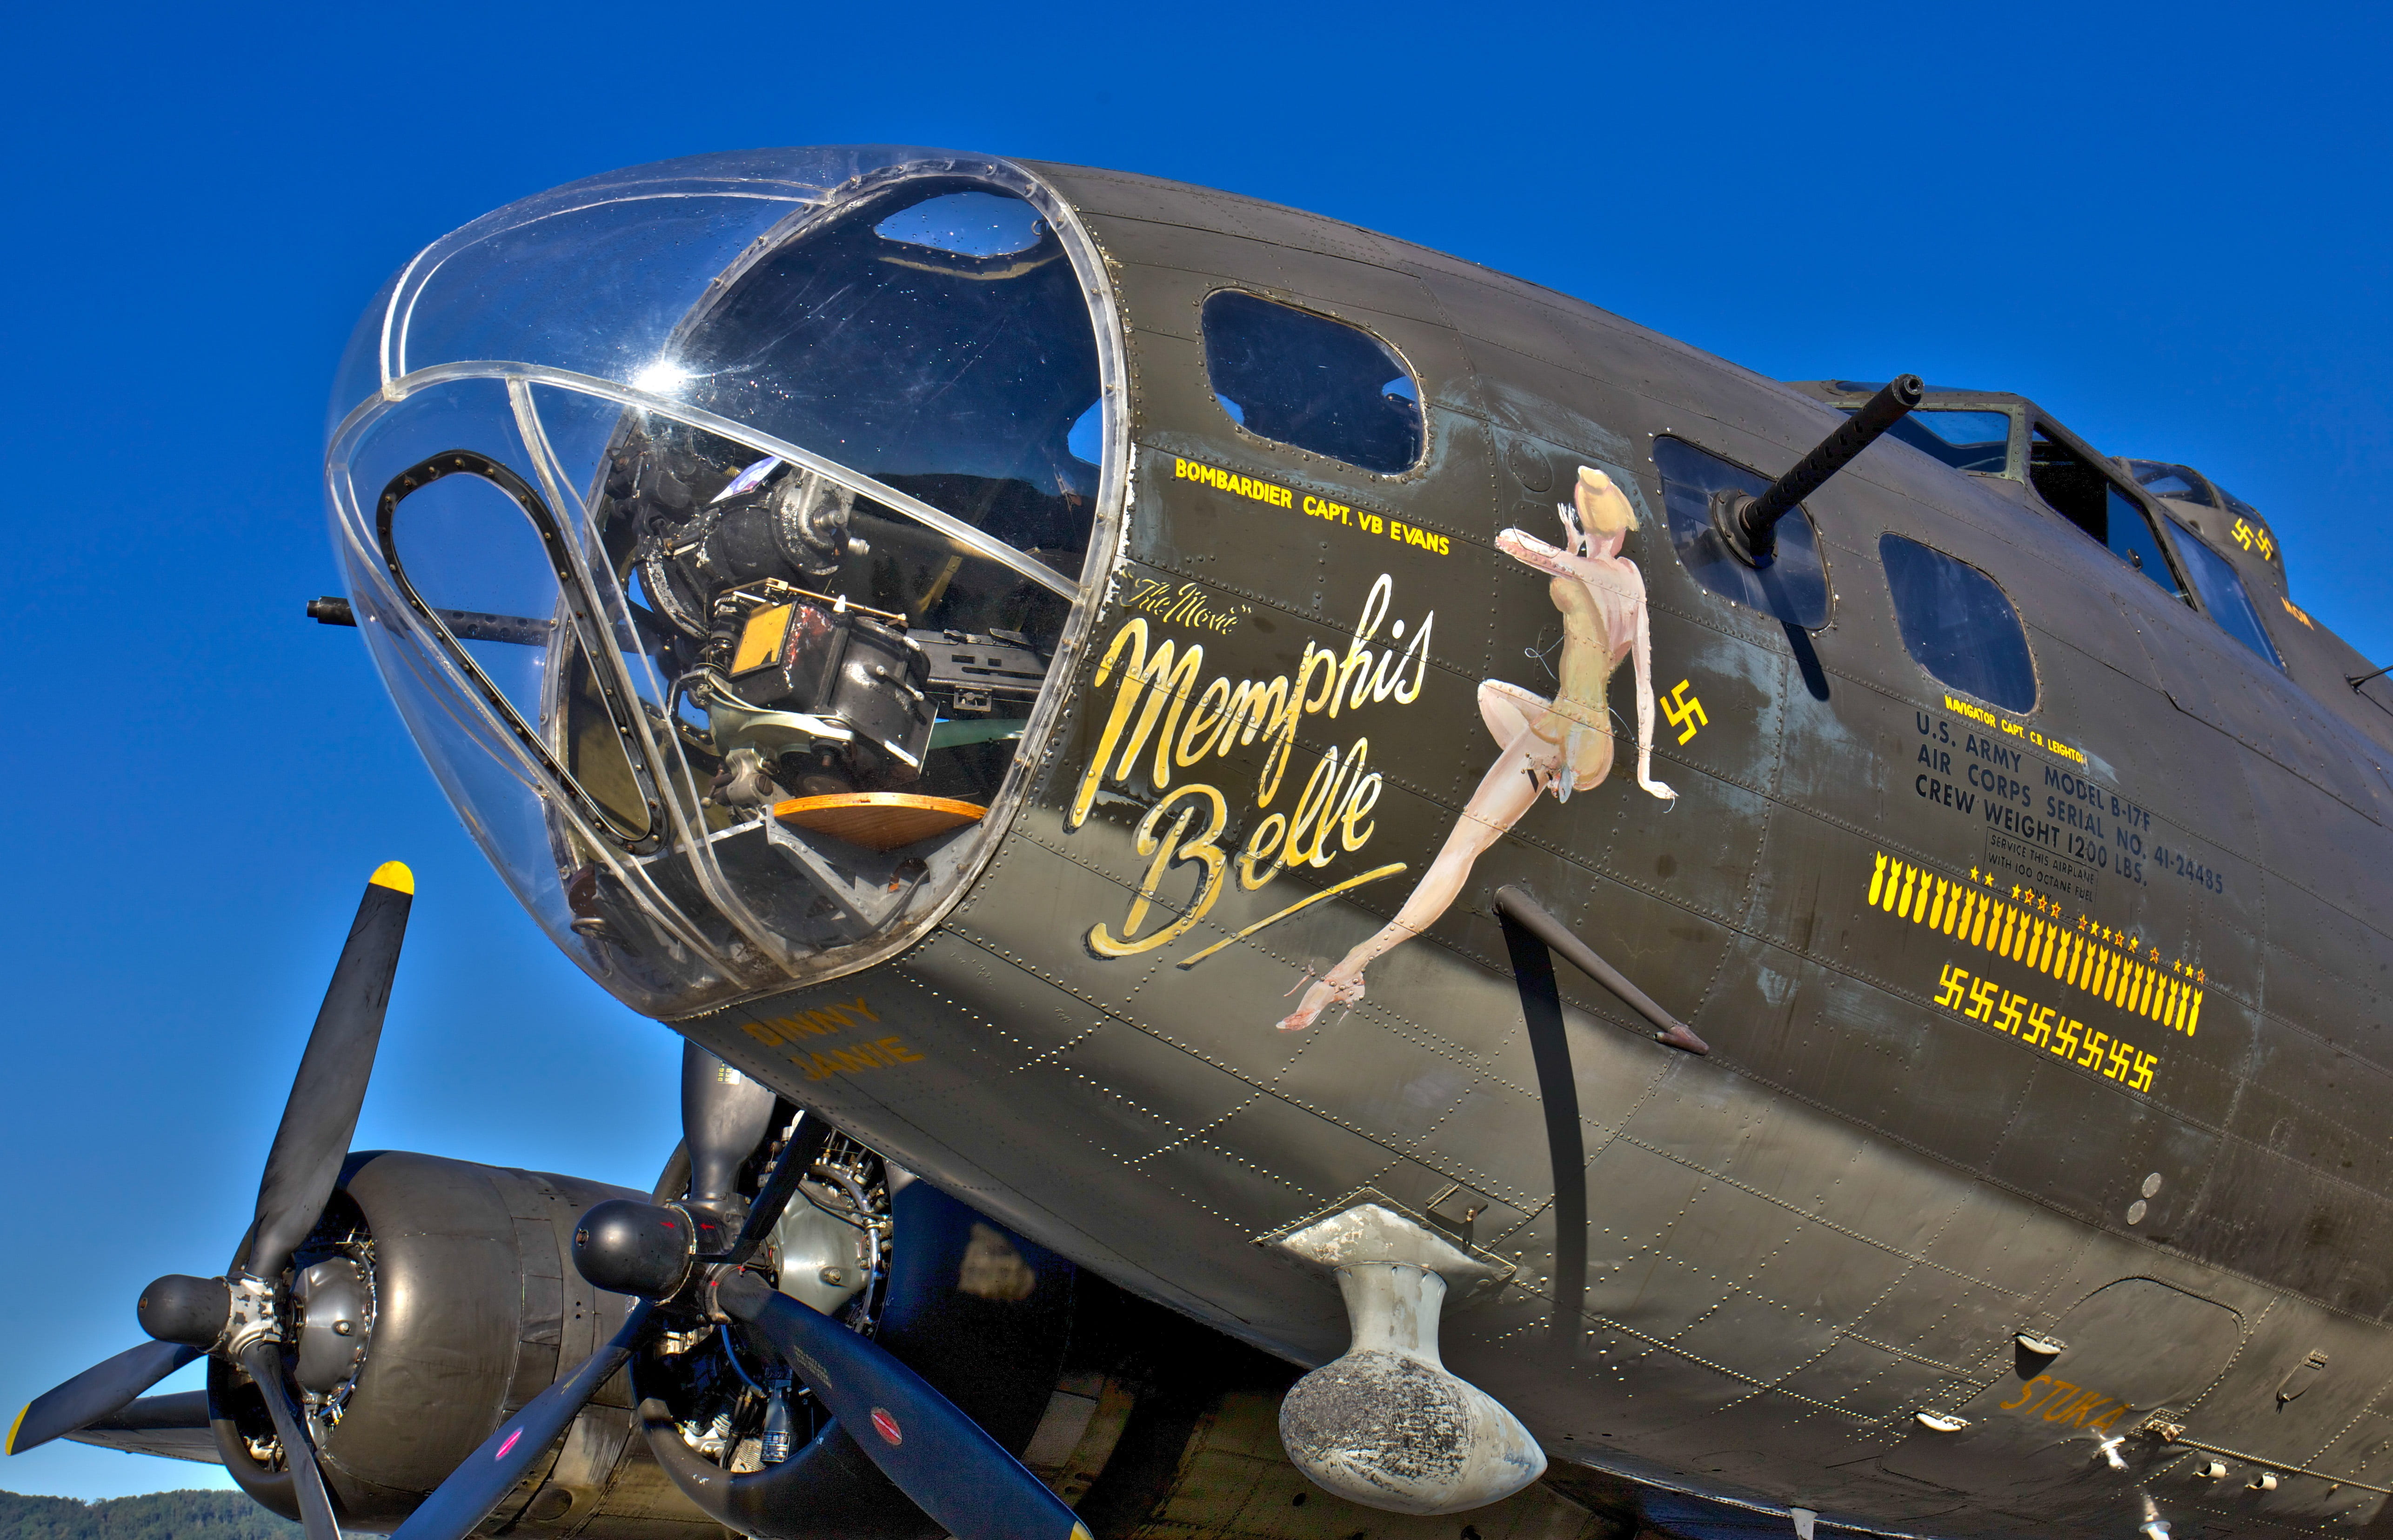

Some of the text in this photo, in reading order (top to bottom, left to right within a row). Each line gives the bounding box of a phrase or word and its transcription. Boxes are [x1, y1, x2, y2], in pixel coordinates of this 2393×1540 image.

[1176, 458, 1449, 555] BOMBARDIER CAPT. VB EVANS
[1072, 573, 1434, 828] Memphis
[1945, 695, 1996, 728] NAVIGATOR
[2001, 719, 2025, 739] CAPT.
[2030, 731, 2044, 747] C.B.
[1917, 711, 2150, 831] U.S. ARMY MODEL B-17F
[1090, 737, 1382, 956] Belle
[1916, 774, 2147, 887] CREW WEIGHT 1200 LBS.
[1918, 744, 2223, 894] AIR CORPS SERIAL NO. 41-24485
[1989, 852, 2092, 902] WITH 100 OCTANE FUEL
[1991, 834, 2094, 884] SERVICE THIS AIRPLANE
[740, 997, 880, 1047] DINNY
[791, 1035, 925, 1081] JANIE
[2000, 1374, 2132, 1433] STUKA
